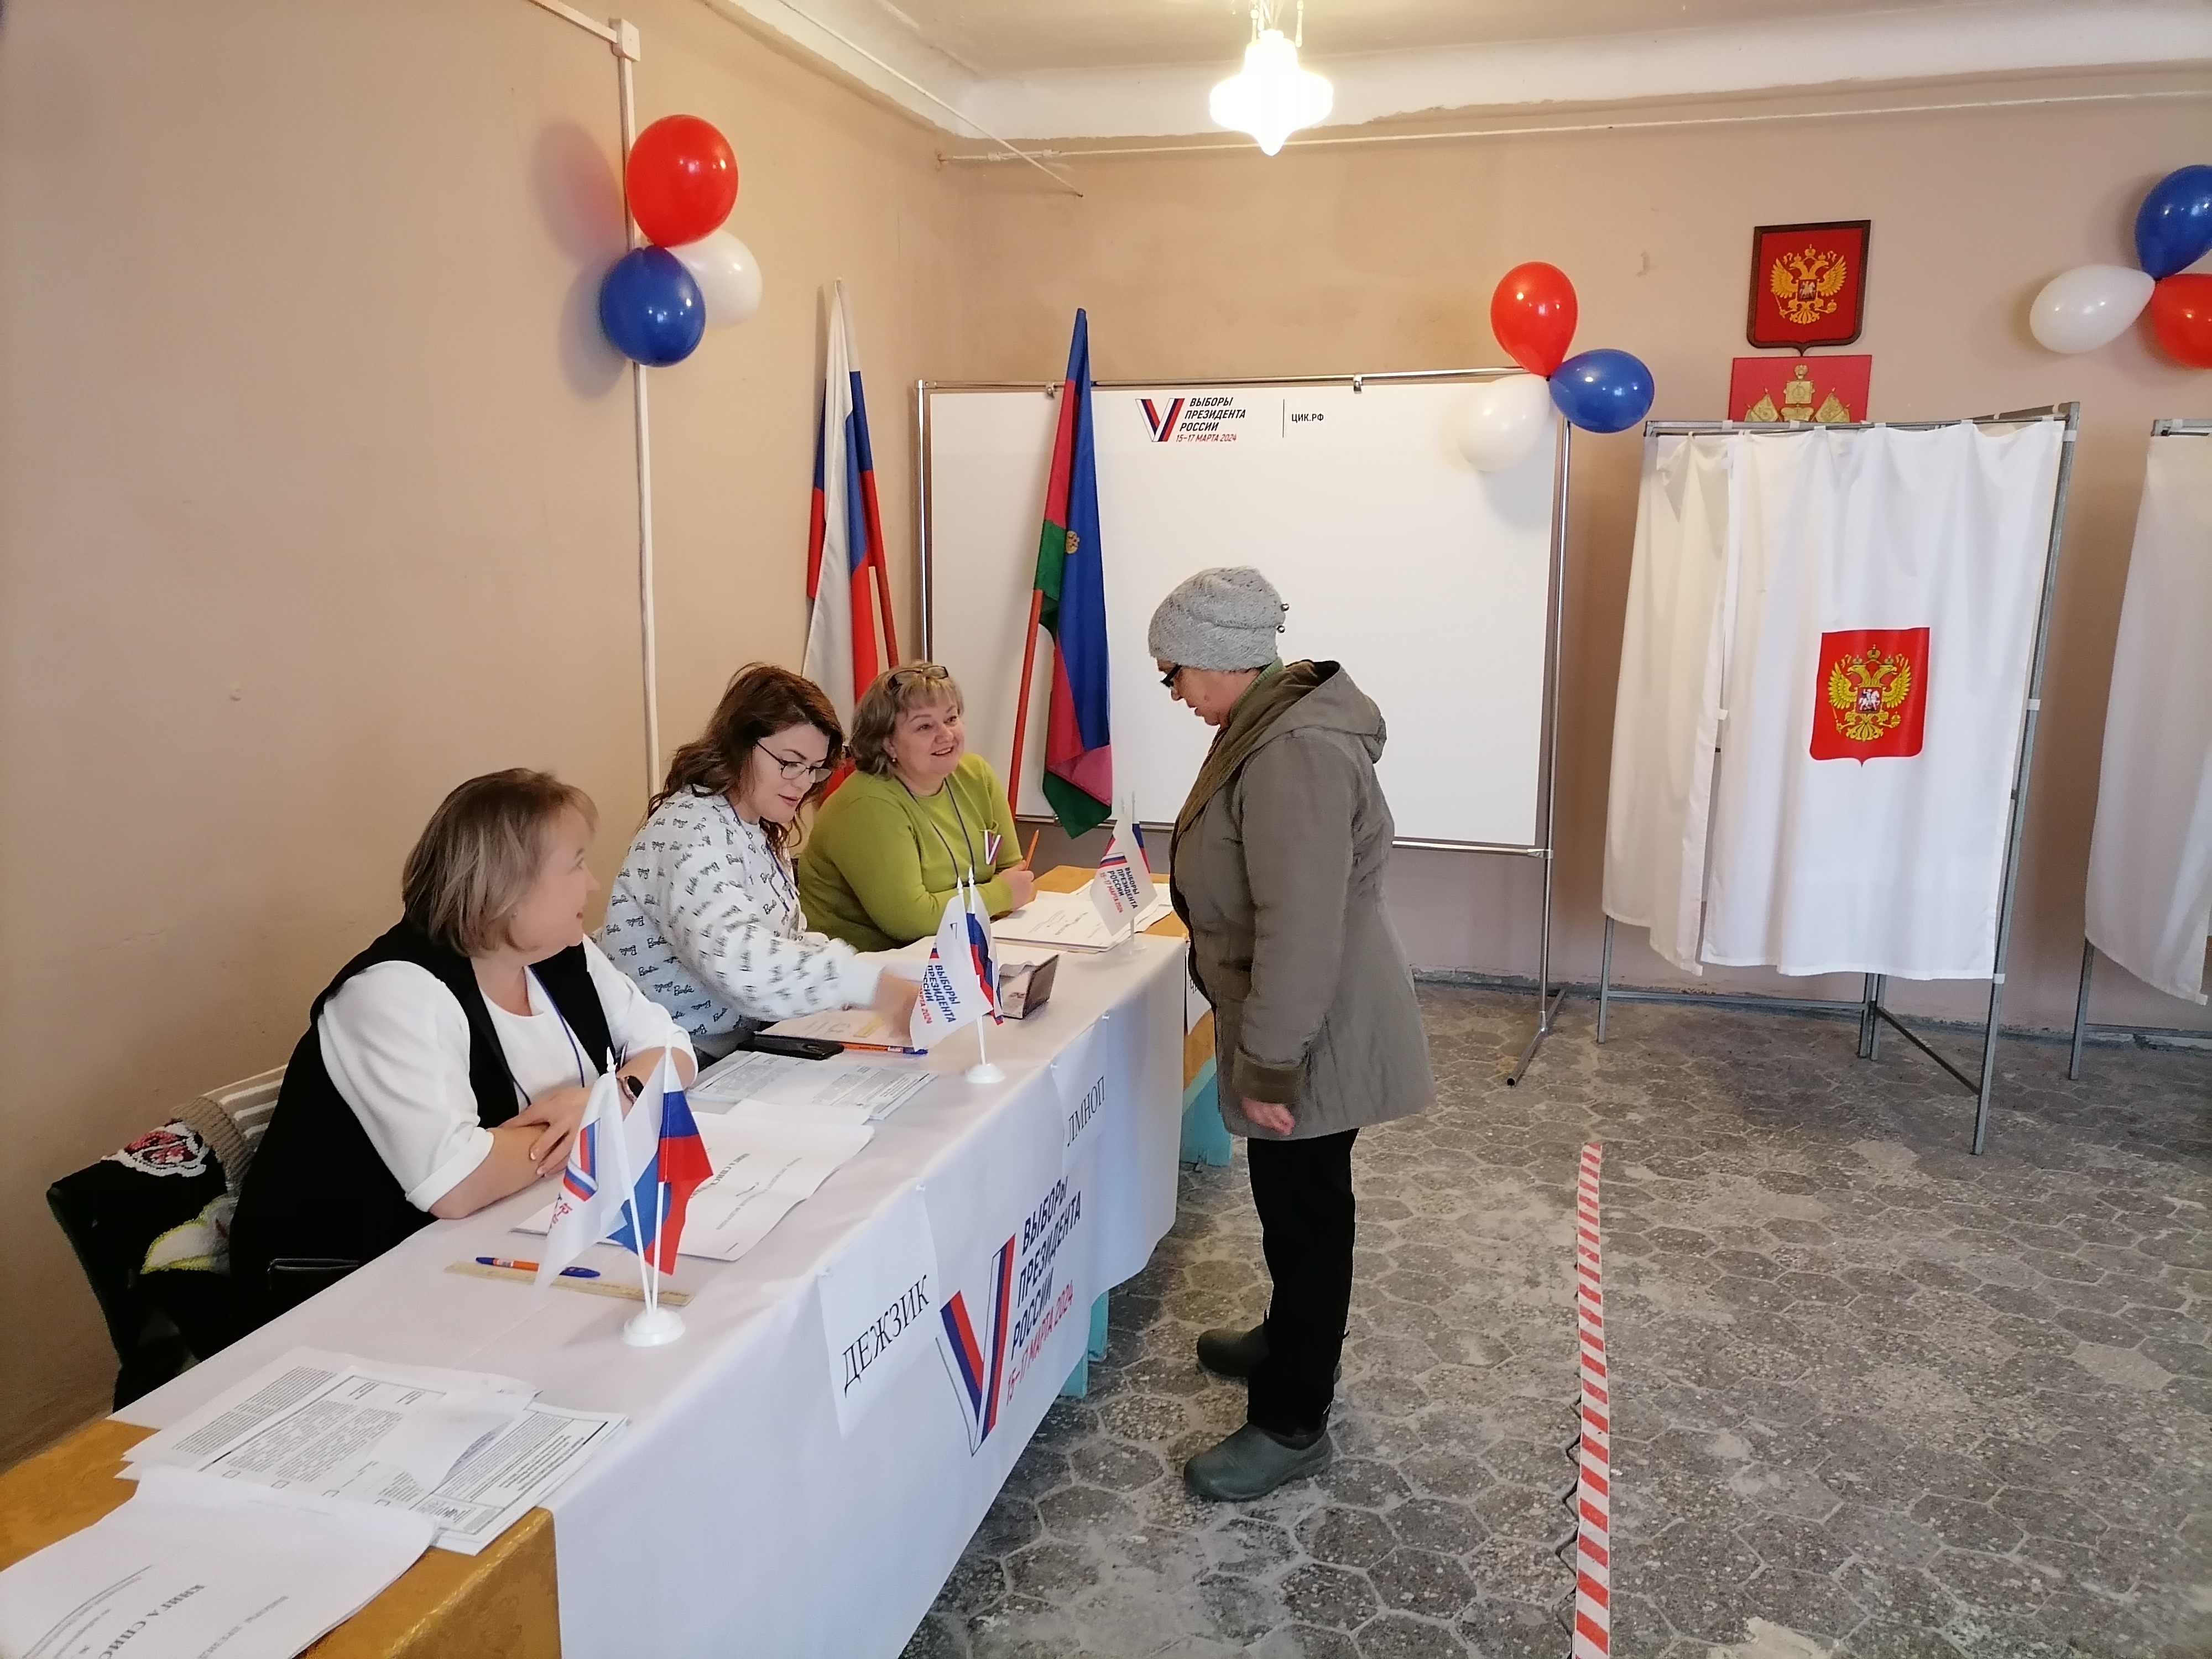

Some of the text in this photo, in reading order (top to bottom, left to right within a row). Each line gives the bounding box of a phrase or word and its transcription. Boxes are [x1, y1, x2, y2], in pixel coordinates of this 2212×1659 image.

[1185, 409, 1246, 420] ПРЕЗИДЕНТА
[1190, 397, 1234, 406] ВЫБОРЫ
[1180, 422, 1219, 431] РОССИИ
[1291, 413, 1324, 423] ЦИК.РФ
[1196, 434, 1219, 442] МАРТА
[1220, 434, 1237, 442] 2024
[1107, 870, 1124, 896] РОССИИ
[1107, 885, 1119, 901] МАРТА
[1117, 869, 1138, 909] ПРЕЗИДЕНТА
[1125, 867, 1140, 895] ВЫБОРЫ
[674, 984, 695, 995] Barbie
[923, 972, 935, 1001] ССИИ
[927, 965, 957, 1022] ПРЕЗИДЕНТА
[935, 965, 961, 1005] ВЫБОРЫ
[921, 1008, 932, 1024] 2024
[1022, 1175, 1068, 1256] ВЫБОРЫ
[1018, 1190, 1081, 1309] ПРЕЗИДЕНТА
[1011, 1266, 1054, 1361] РОССИИ
[1029, 1306, 1054, 1363] МАРТА
[1054, 1279, 1073, 1327] 2024
[842, 1274, 930, 1399] ДЕЖЗИК
